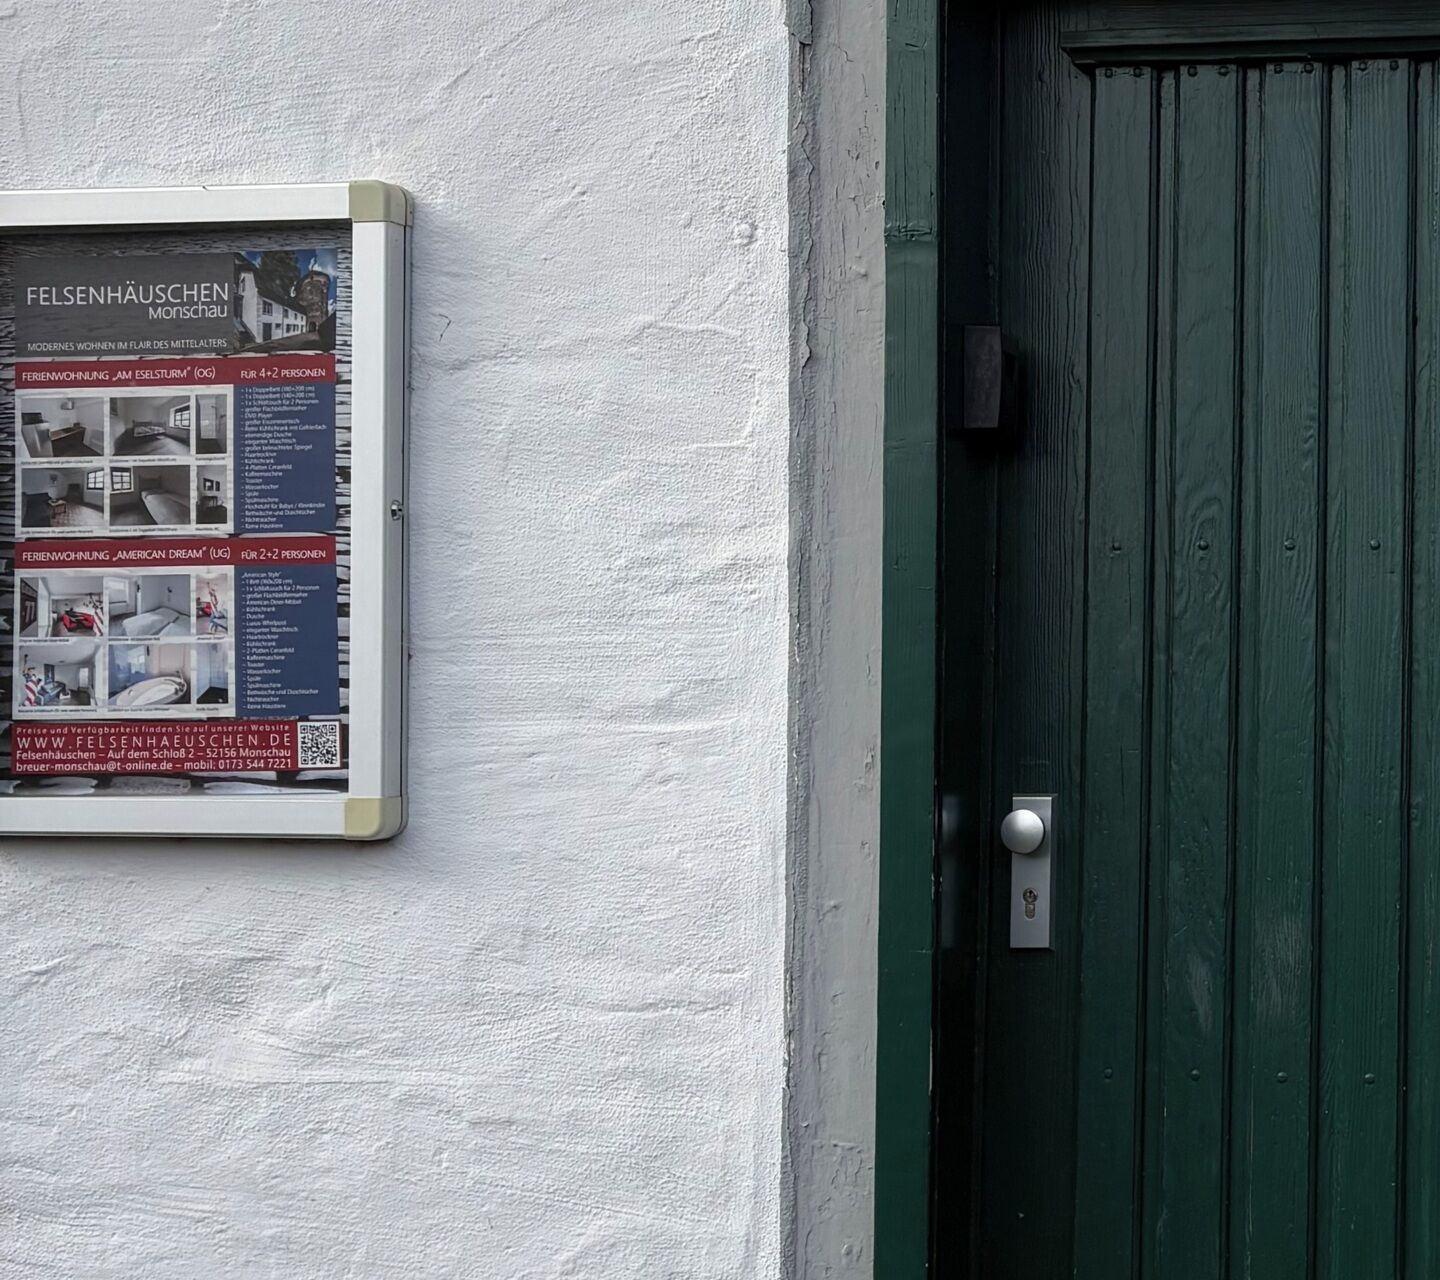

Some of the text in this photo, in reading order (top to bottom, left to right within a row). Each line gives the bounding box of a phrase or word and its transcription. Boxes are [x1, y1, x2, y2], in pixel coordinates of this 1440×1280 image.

[27, 280, 229, 305] FELSENHÄUSCHEN
[149, 301, 227, 319] Monschau
[28, 339, 226, 351] MODERNES WOHNEN IM FLAIR DES MITTELALTERS
[22, 371, 109, 381] FERIENWOHNUNG
[195, 366, 215, 379] (OG)
[241, 368, 325, 378] FÜR 4+2 PERSONEN
[23, 551, 109, 561] FERIENWOHNUNG
[209, 546, 231, 560] (UG)
[242, 549, 326, 559] FÜR 2+2 PERSONEN
[71, 726, 138, 735] Verfügbarkeit
[17, 733, 291, 749] WWW.FELSENHAEUSCHEN.DE
[16, 750, 95, 760] Felsenhäuschen
[108, 750, 124, 759] Auf
[128, 750, 149, 758] dem
[152, 748, 185, 758] Schloß
[206, 748, 236, 758] 52156
[240, 748, 291, 757] Monschau
[16, 760, 173, 772] breuer-monschau@t-online.de
[184, 760, 216, 769] mobil:
[219, 760, 242, 769] 0173
[247, 759, 264, 768] 544
[268, 759, 291, 768] 7221
